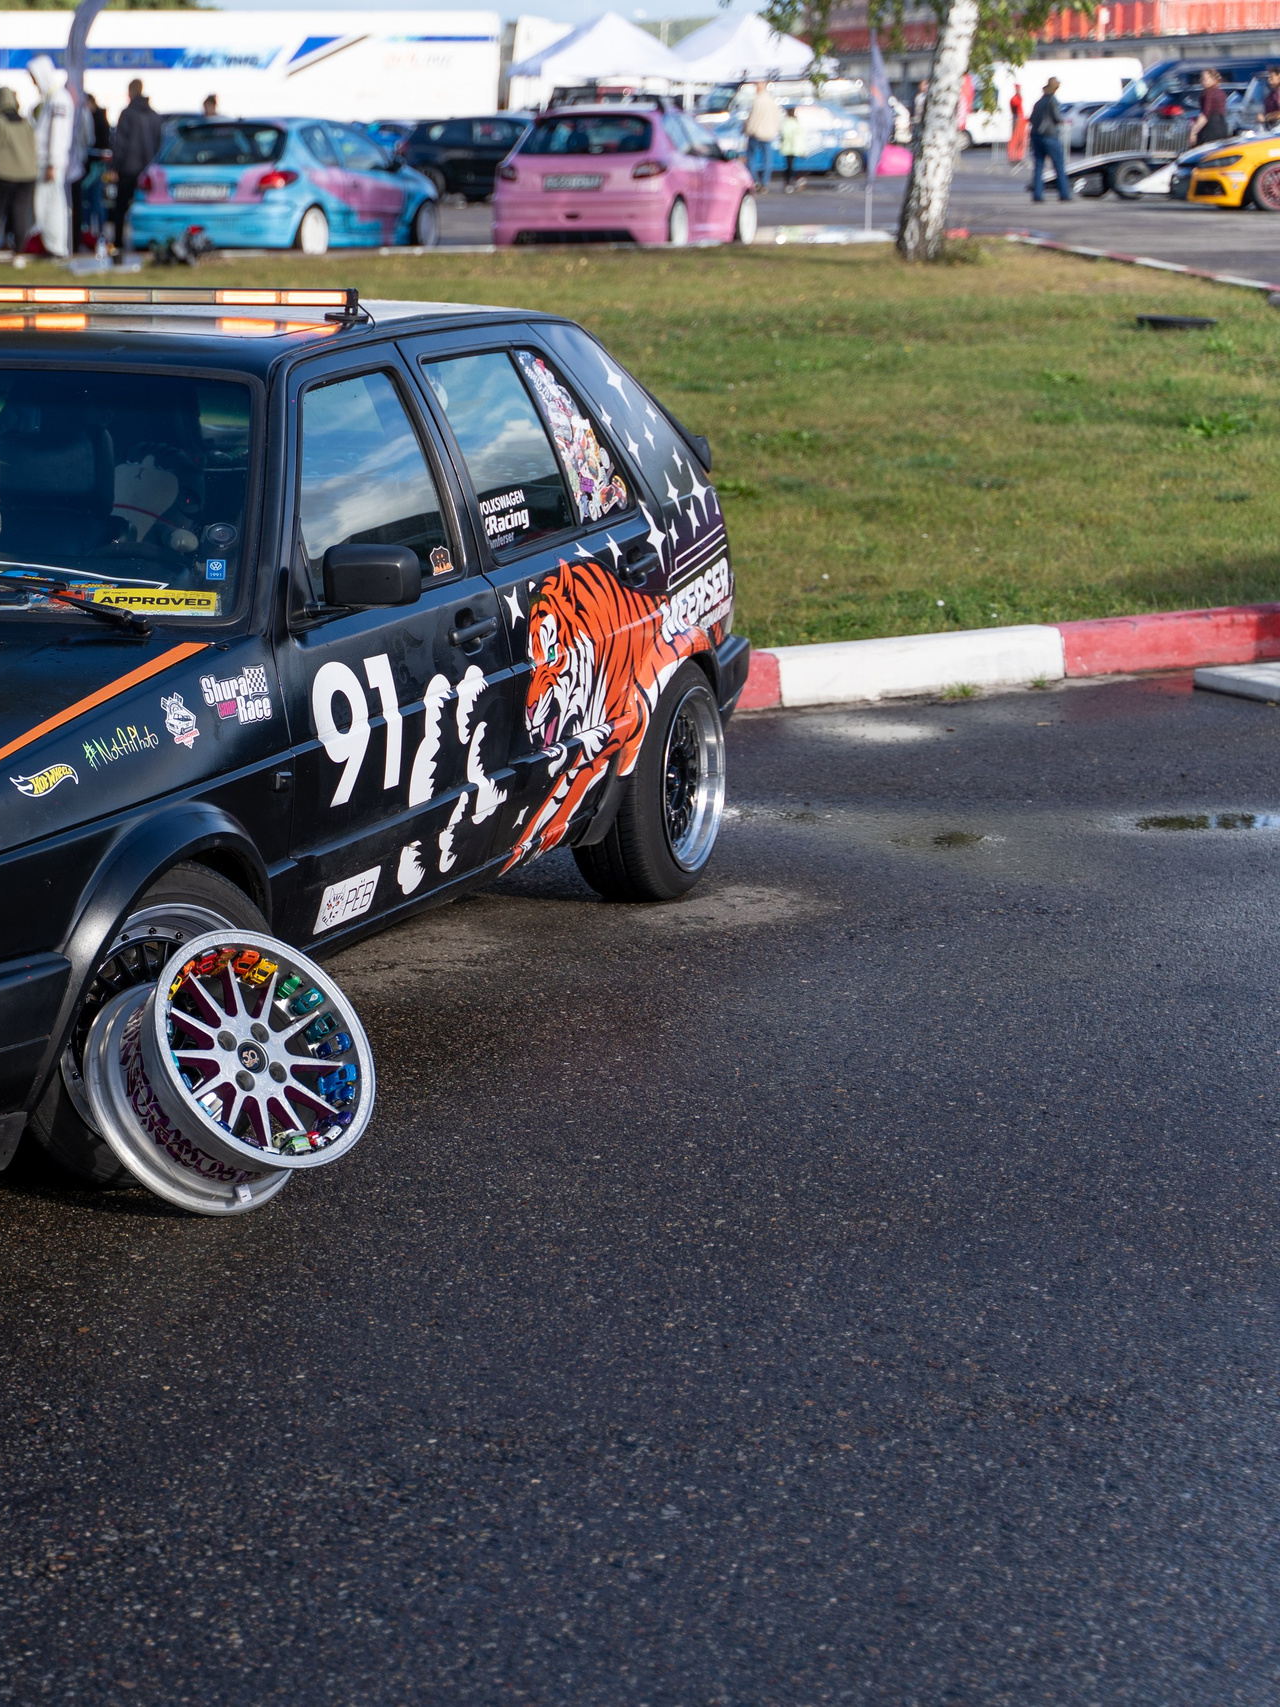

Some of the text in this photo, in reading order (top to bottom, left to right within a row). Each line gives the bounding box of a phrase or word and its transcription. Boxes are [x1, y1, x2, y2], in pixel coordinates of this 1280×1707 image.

[100, 596, 211, 606] APPROVED
[201, 676, 249, 705] Shura
[218, 700, 237, 717] SHOP
[236, 695, 272, 723] Race
[312, 653, 403, 808] 91
[29, 772, 49, 795] HOT
[242, 1049, 258, 1064] 50
